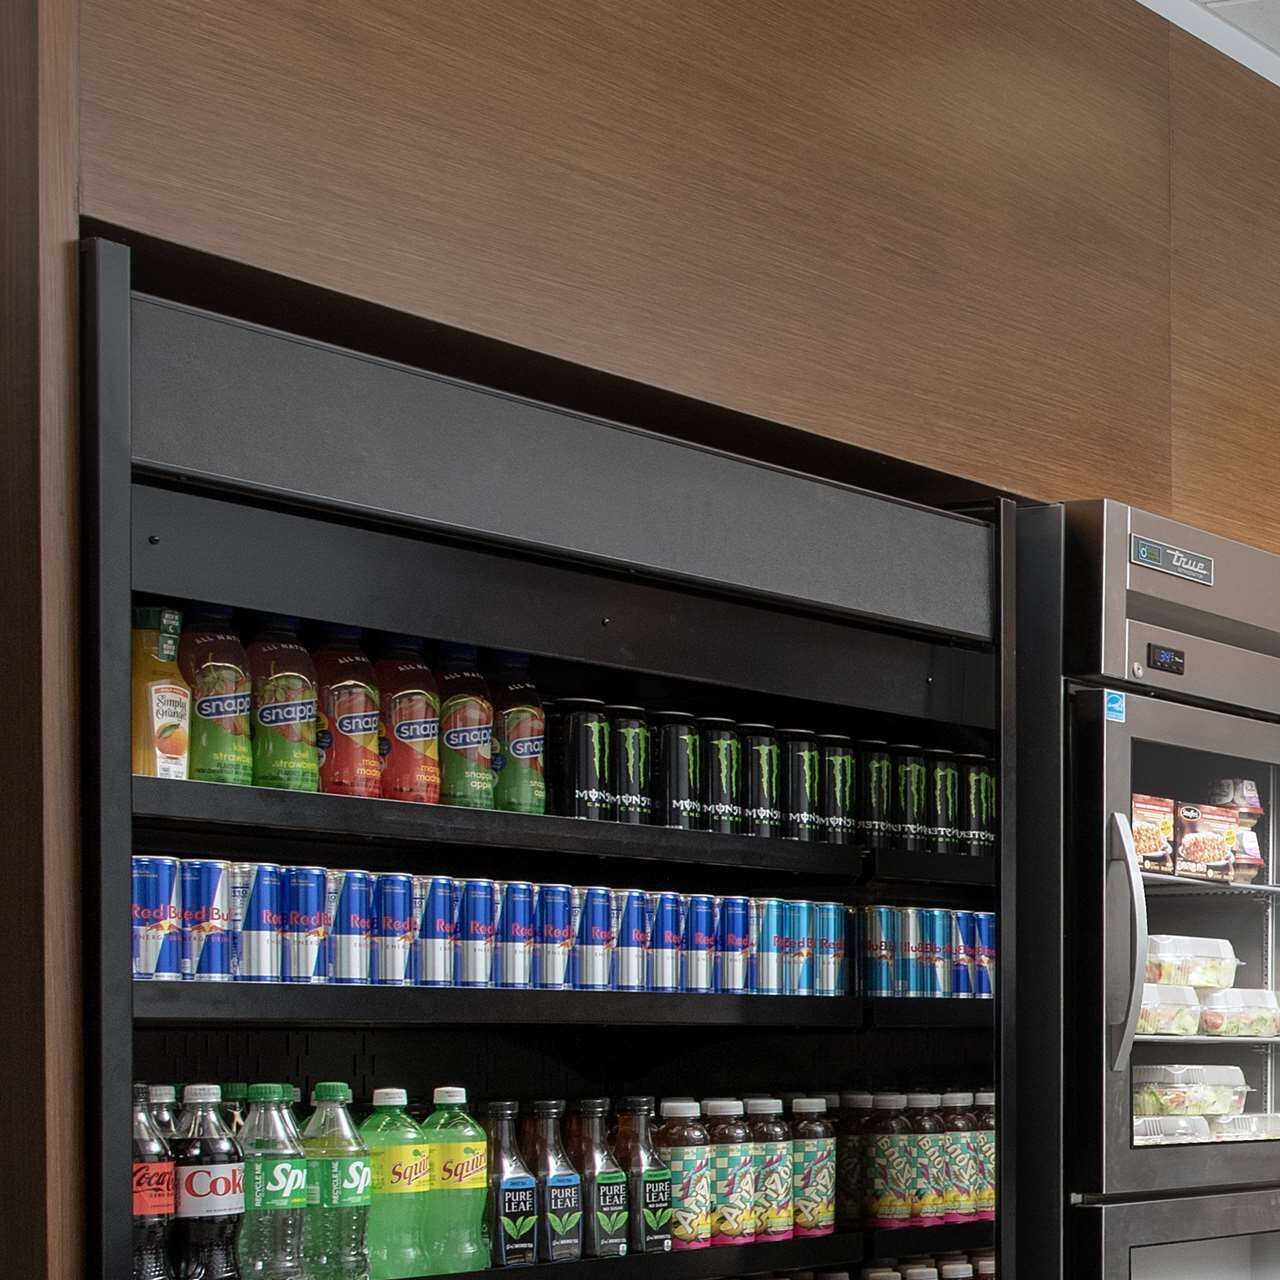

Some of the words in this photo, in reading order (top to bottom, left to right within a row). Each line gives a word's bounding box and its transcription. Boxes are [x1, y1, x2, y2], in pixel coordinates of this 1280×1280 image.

[156, 694, 187, 713] Simply
[551, 1187, 577, 1200] PURE
[600, 1185, 626, 1196] PURE
[646, 1182, 671, 1194] PURE
[505, 1189, 533, 1202] PURE
